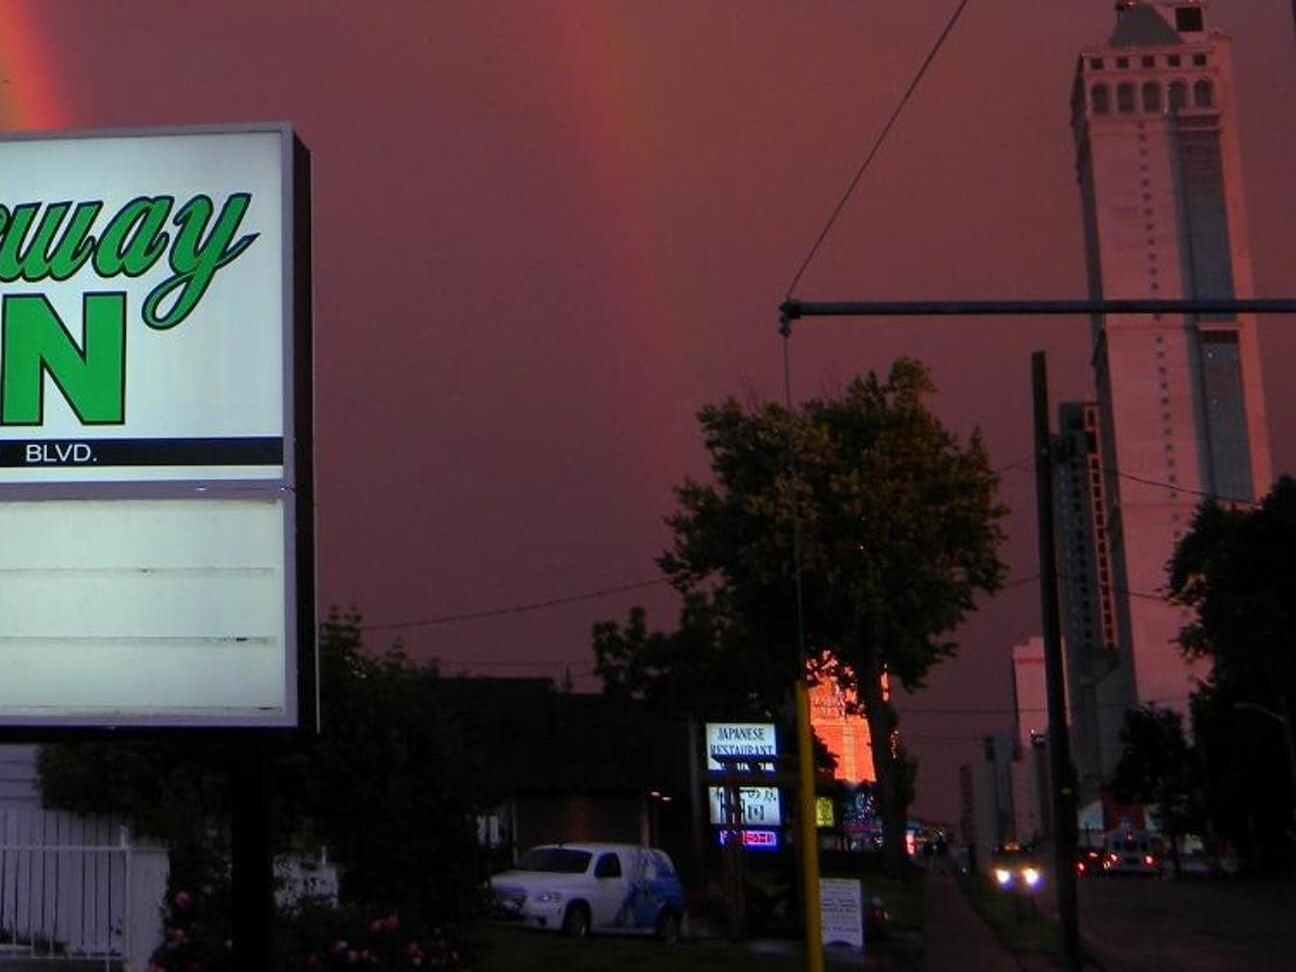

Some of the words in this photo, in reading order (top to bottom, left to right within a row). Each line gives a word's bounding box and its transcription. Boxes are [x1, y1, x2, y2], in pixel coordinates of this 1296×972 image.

[25, 443, 98, 464] BLVD.
[717, 727, 765, 741] JAPANESE
[711, 744, 773, 756] RESTAURANT
